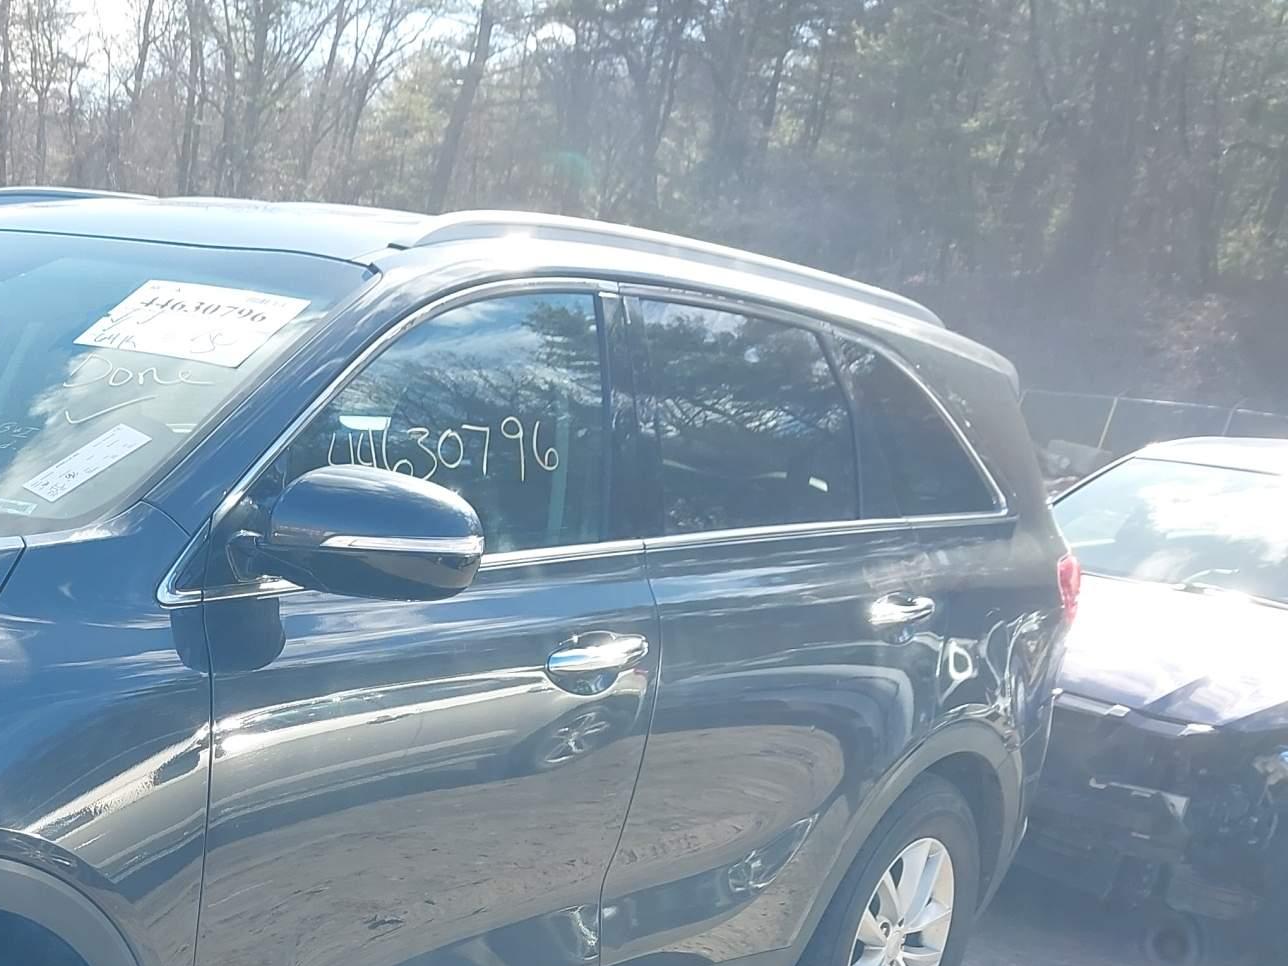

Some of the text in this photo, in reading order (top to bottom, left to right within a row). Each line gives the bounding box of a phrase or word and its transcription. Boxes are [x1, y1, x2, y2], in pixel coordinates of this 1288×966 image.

[140, 296, 267, 322] 44630796
[62, 353, 215, 388] Done
[327, 416, 559, 482] 44630796
